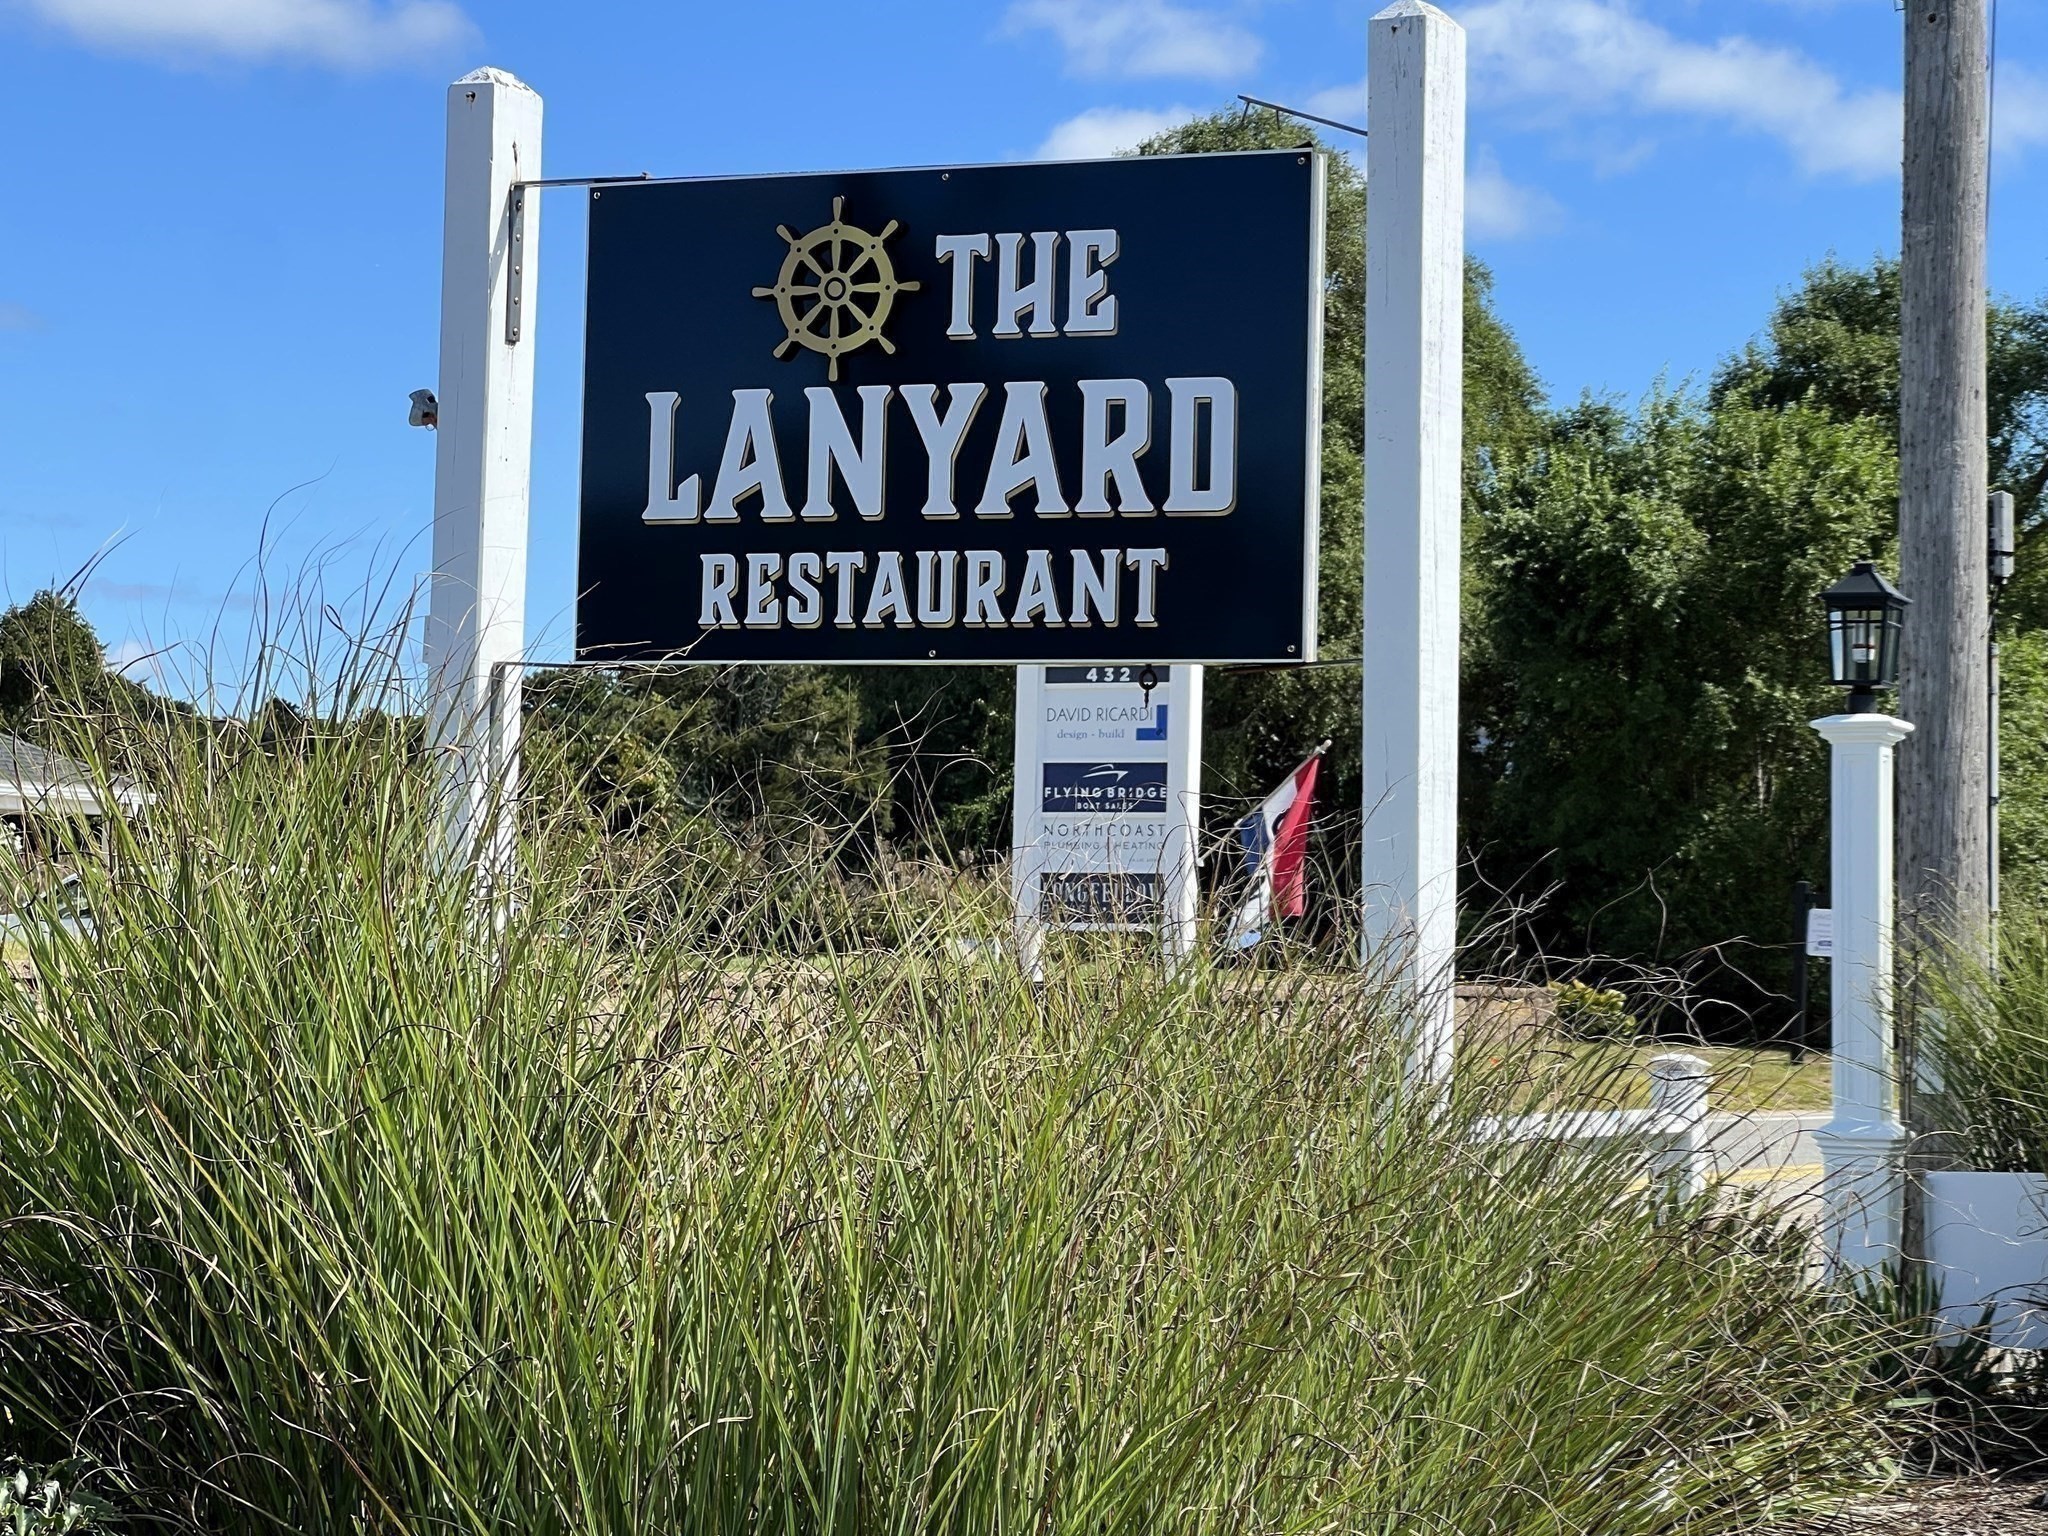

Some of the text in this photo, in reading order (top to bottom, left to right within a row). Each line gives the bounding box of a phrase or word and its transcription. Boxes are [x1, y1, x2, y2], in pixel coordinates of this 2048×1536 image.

[934, 228, 1120, 341] THE
[641, 376, 1238, 526] LANYARD
[698, 547, 1169, 630] RESTAURANT
[1086, 667, 1131, 683] 432
[1046, 706, 1154, 722] DAVID RICARDI
[1056, 729, 1088, 741] design
[1098, 729, 1125, 739] build
[1044, 786, 1168, 798] FLYING BRIDGE
[1077, 802, 1133, 810] BOAT SALES
[1043, 823, 1166, 837] NORTHCOAST
